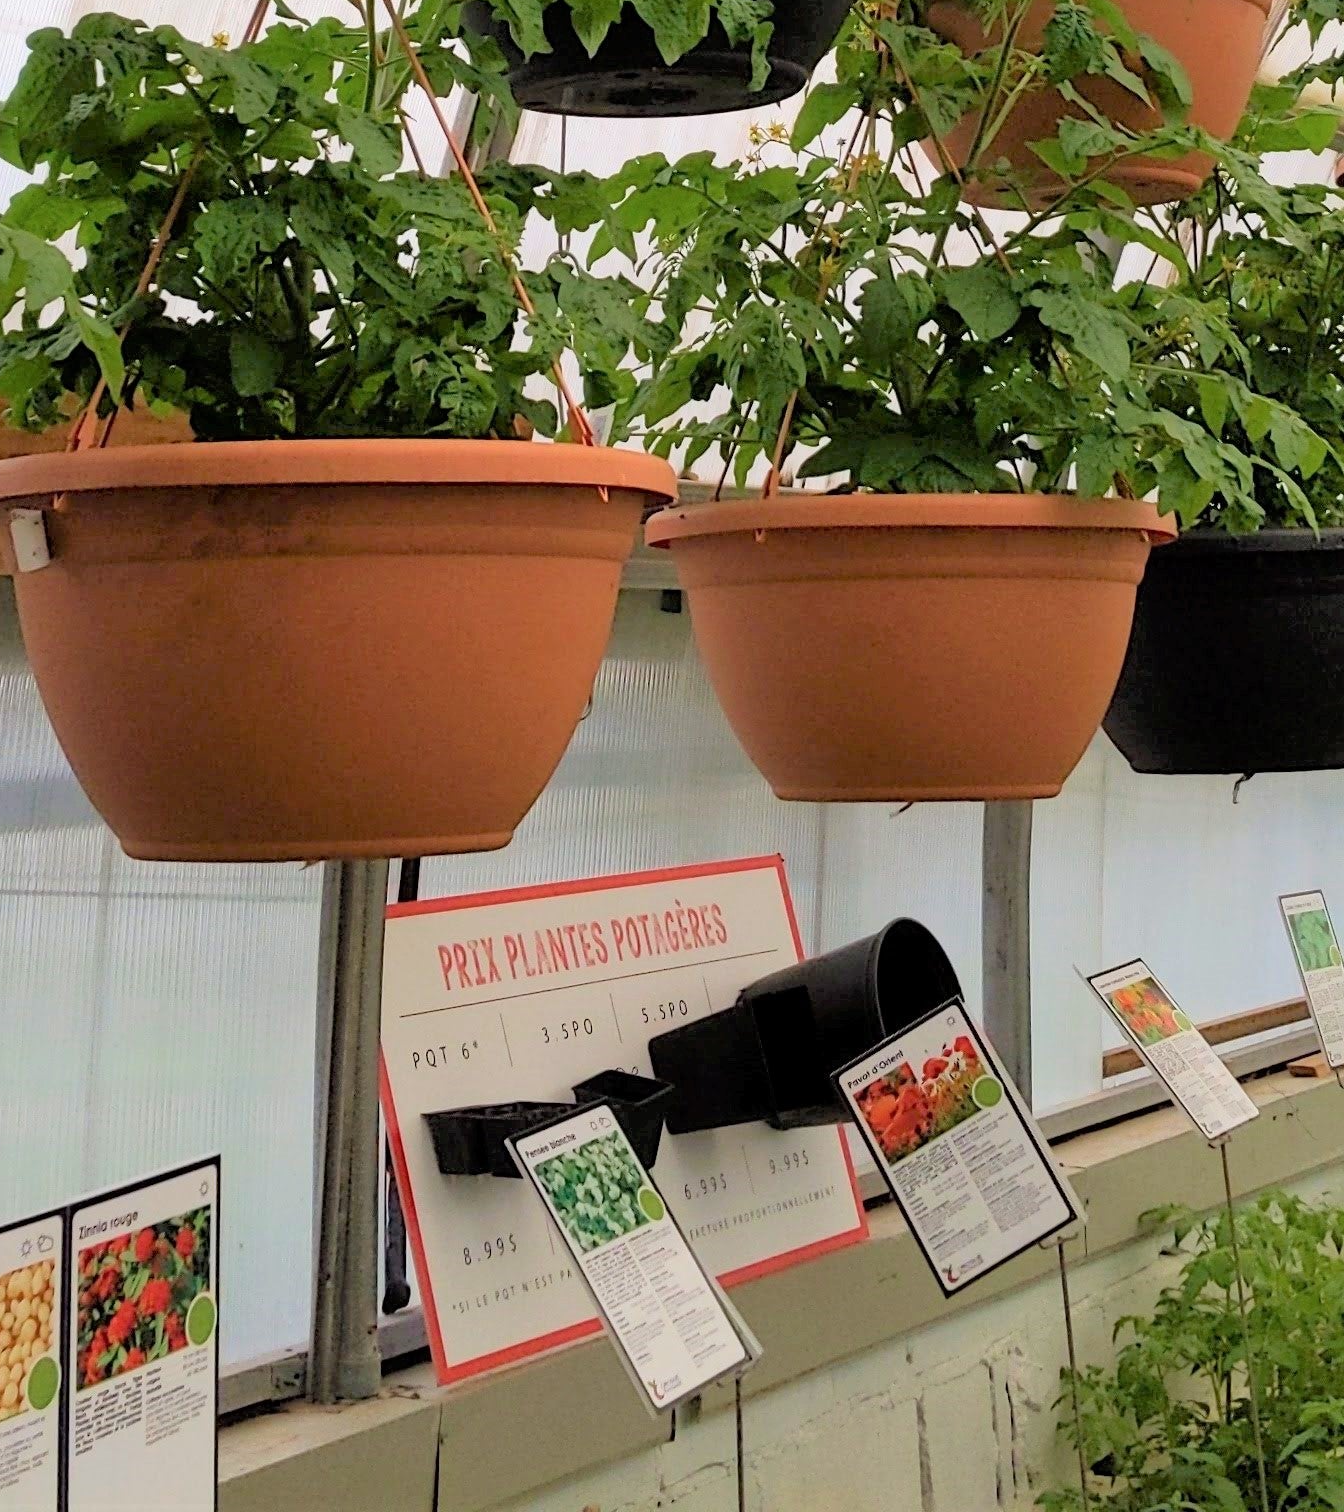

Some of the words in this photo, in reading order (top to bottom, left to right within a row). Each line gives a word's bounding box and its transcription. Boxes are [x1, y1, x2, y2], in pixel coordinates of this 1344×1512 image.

[438, 937, 501, 990] PRIX
[504, 920, 607, 979] PLANTES
[611, 898, 727, 961] POTAGÈRES
[110, 1211, 138, 1227] rouge
